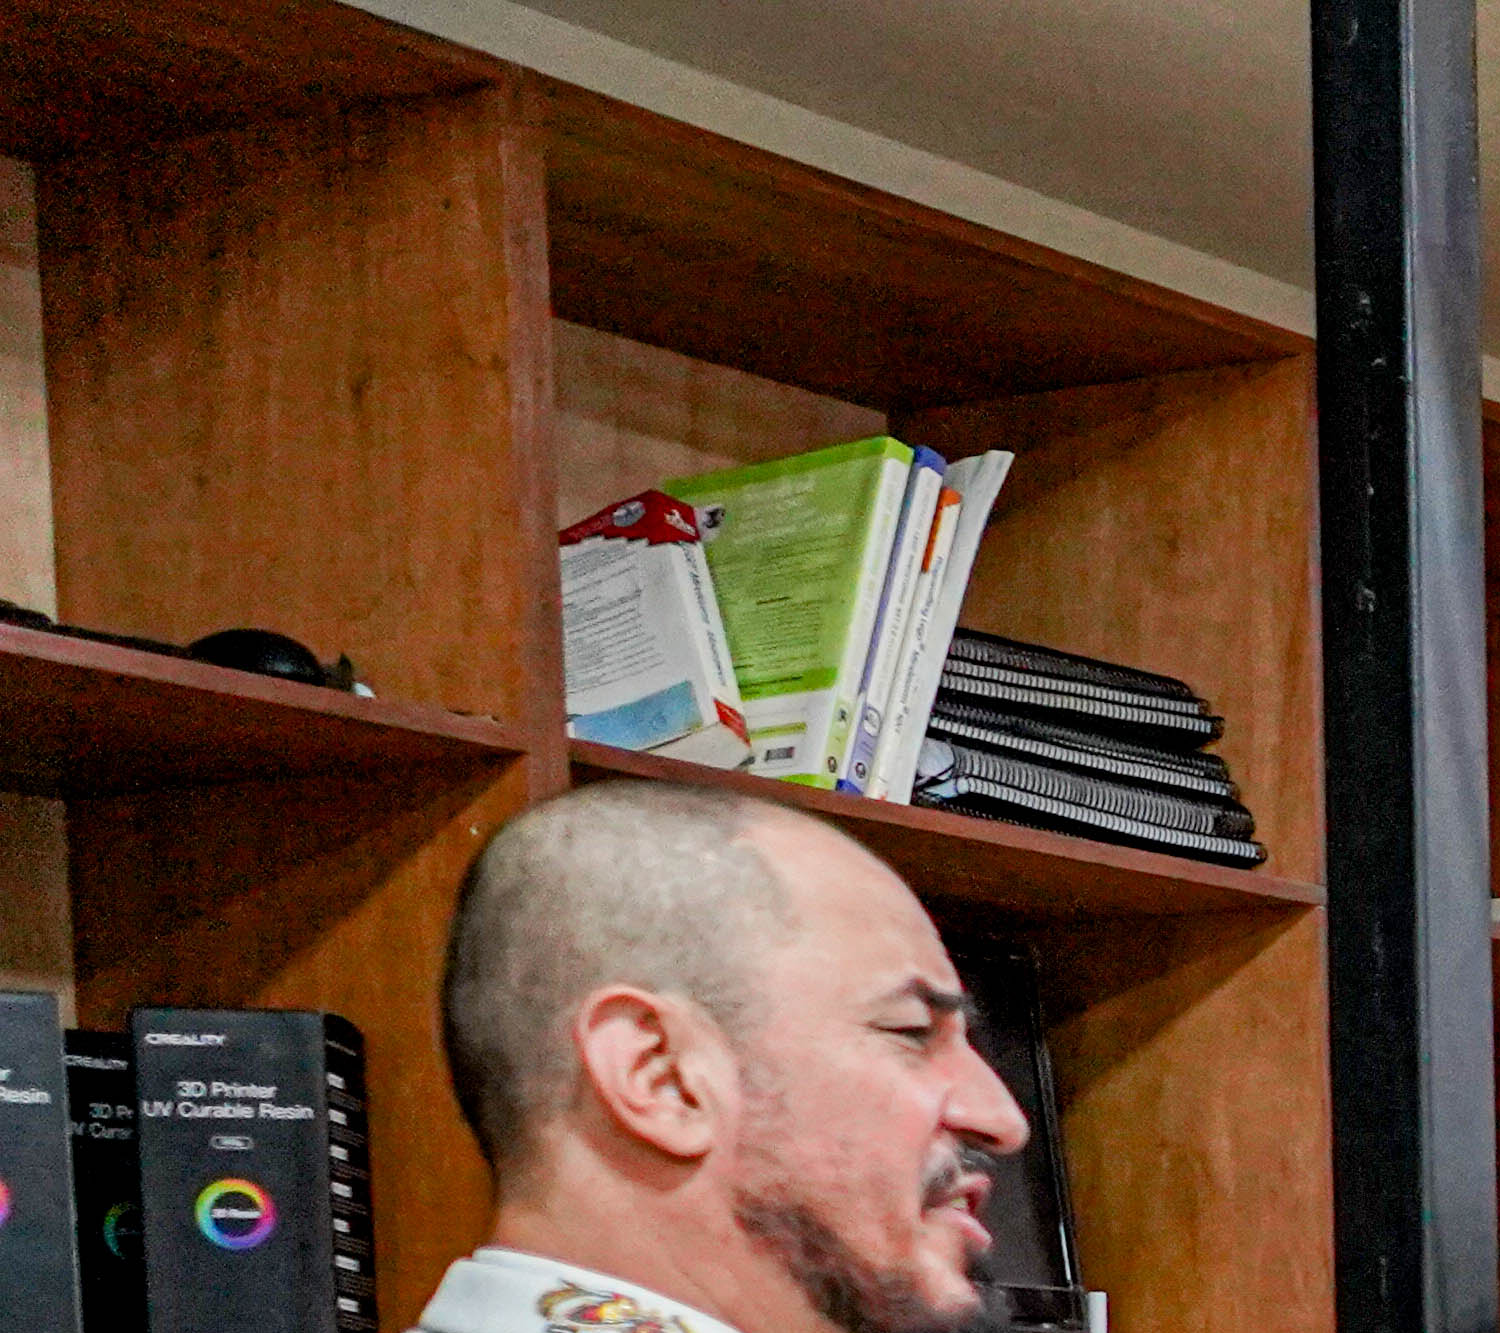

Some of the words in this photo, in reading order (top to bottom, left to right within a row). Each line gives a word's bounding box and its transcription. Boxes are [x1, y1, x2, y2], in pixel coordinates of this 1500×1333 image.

[144, 1033, 226, 1046] CREALITY
[176, 1081, 207, 1098] 3D
[211, 1081, 278, 1099] Printer
[143, 1101, 174, 1118] UV
[258, 1103, 315, 1120] Resin
